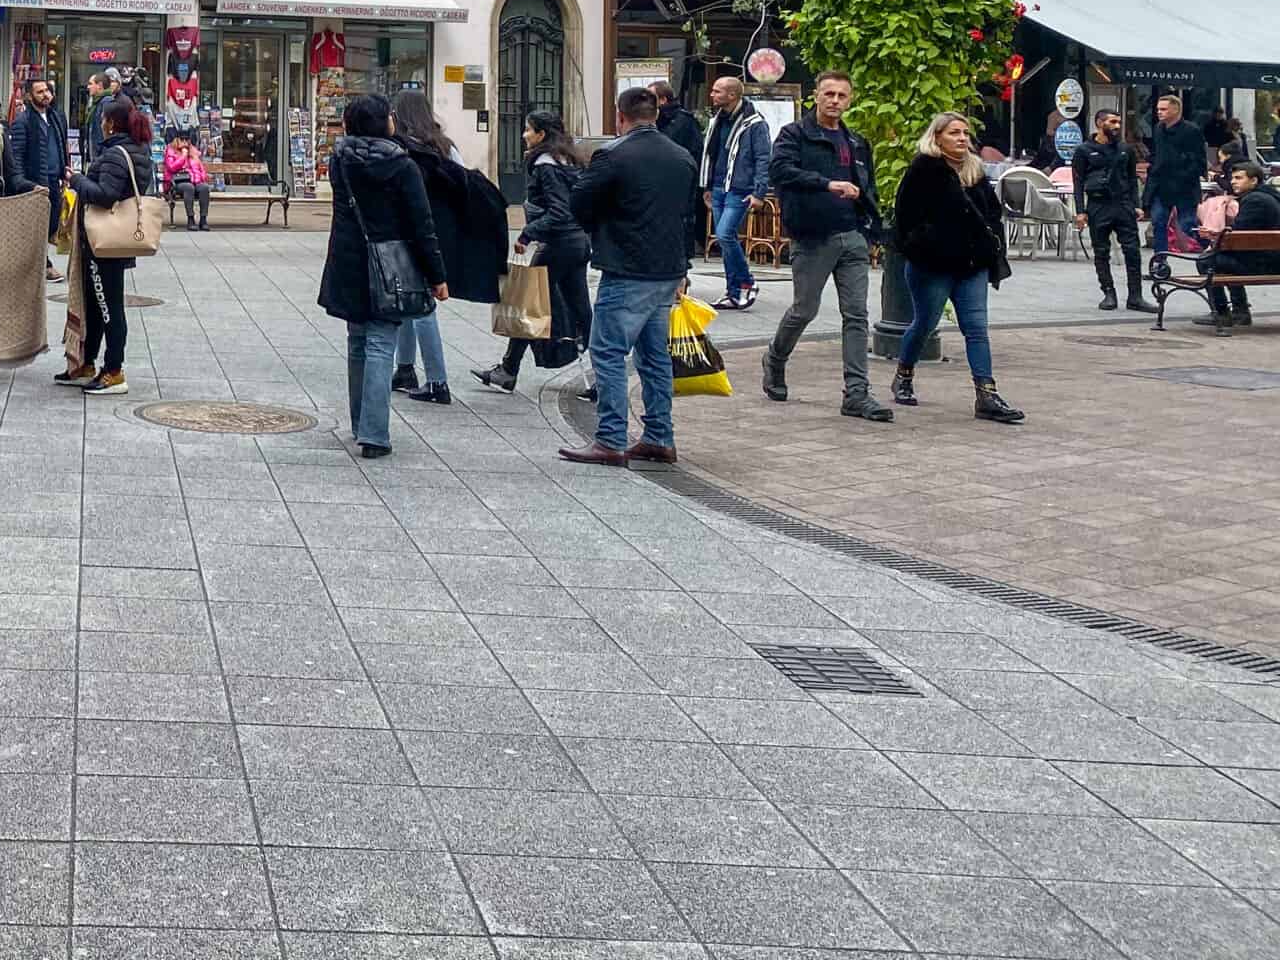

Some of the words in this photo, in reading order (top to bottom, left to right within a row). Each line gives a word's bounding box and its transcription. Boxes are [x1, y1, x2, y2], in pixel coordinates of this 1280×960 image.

[165, 2, 192, 12] CADEAU
[89, 49, 116, 60] OPEN
[1124, 70, 1194, 81] RESTAURANT
[93, 274, 110, 324] adidas
